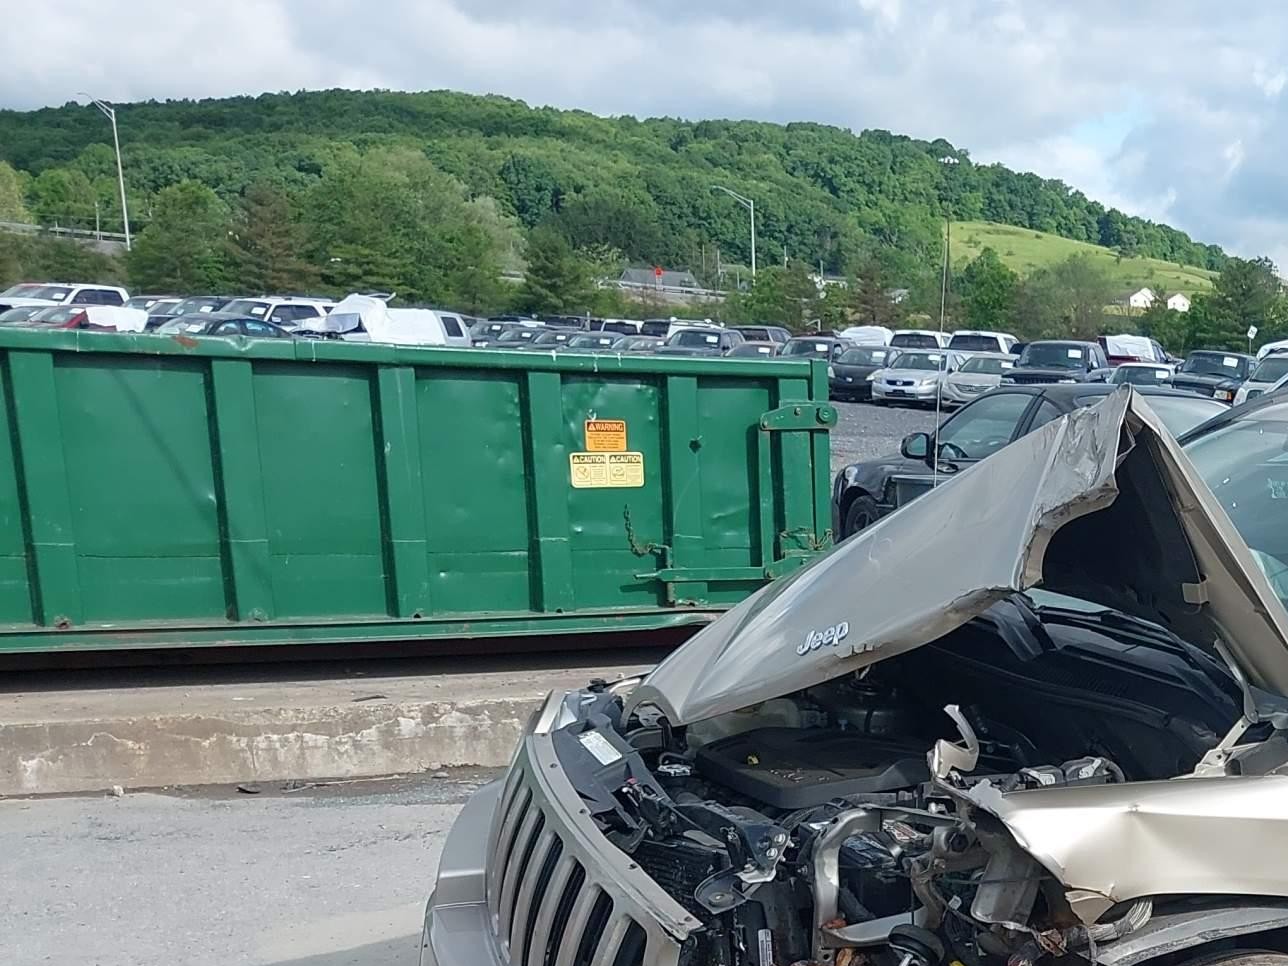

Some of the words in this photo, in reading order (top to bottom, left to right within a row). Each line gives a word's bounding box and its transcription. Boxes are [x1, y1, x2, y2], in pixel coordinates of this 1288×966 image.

[595, 423, 623, 431] WARNING
[580, 455, 606, 463] CAUTION
[616, 455, 641, 463] CAUTION
[797, 621, 849, 656] Jeep
